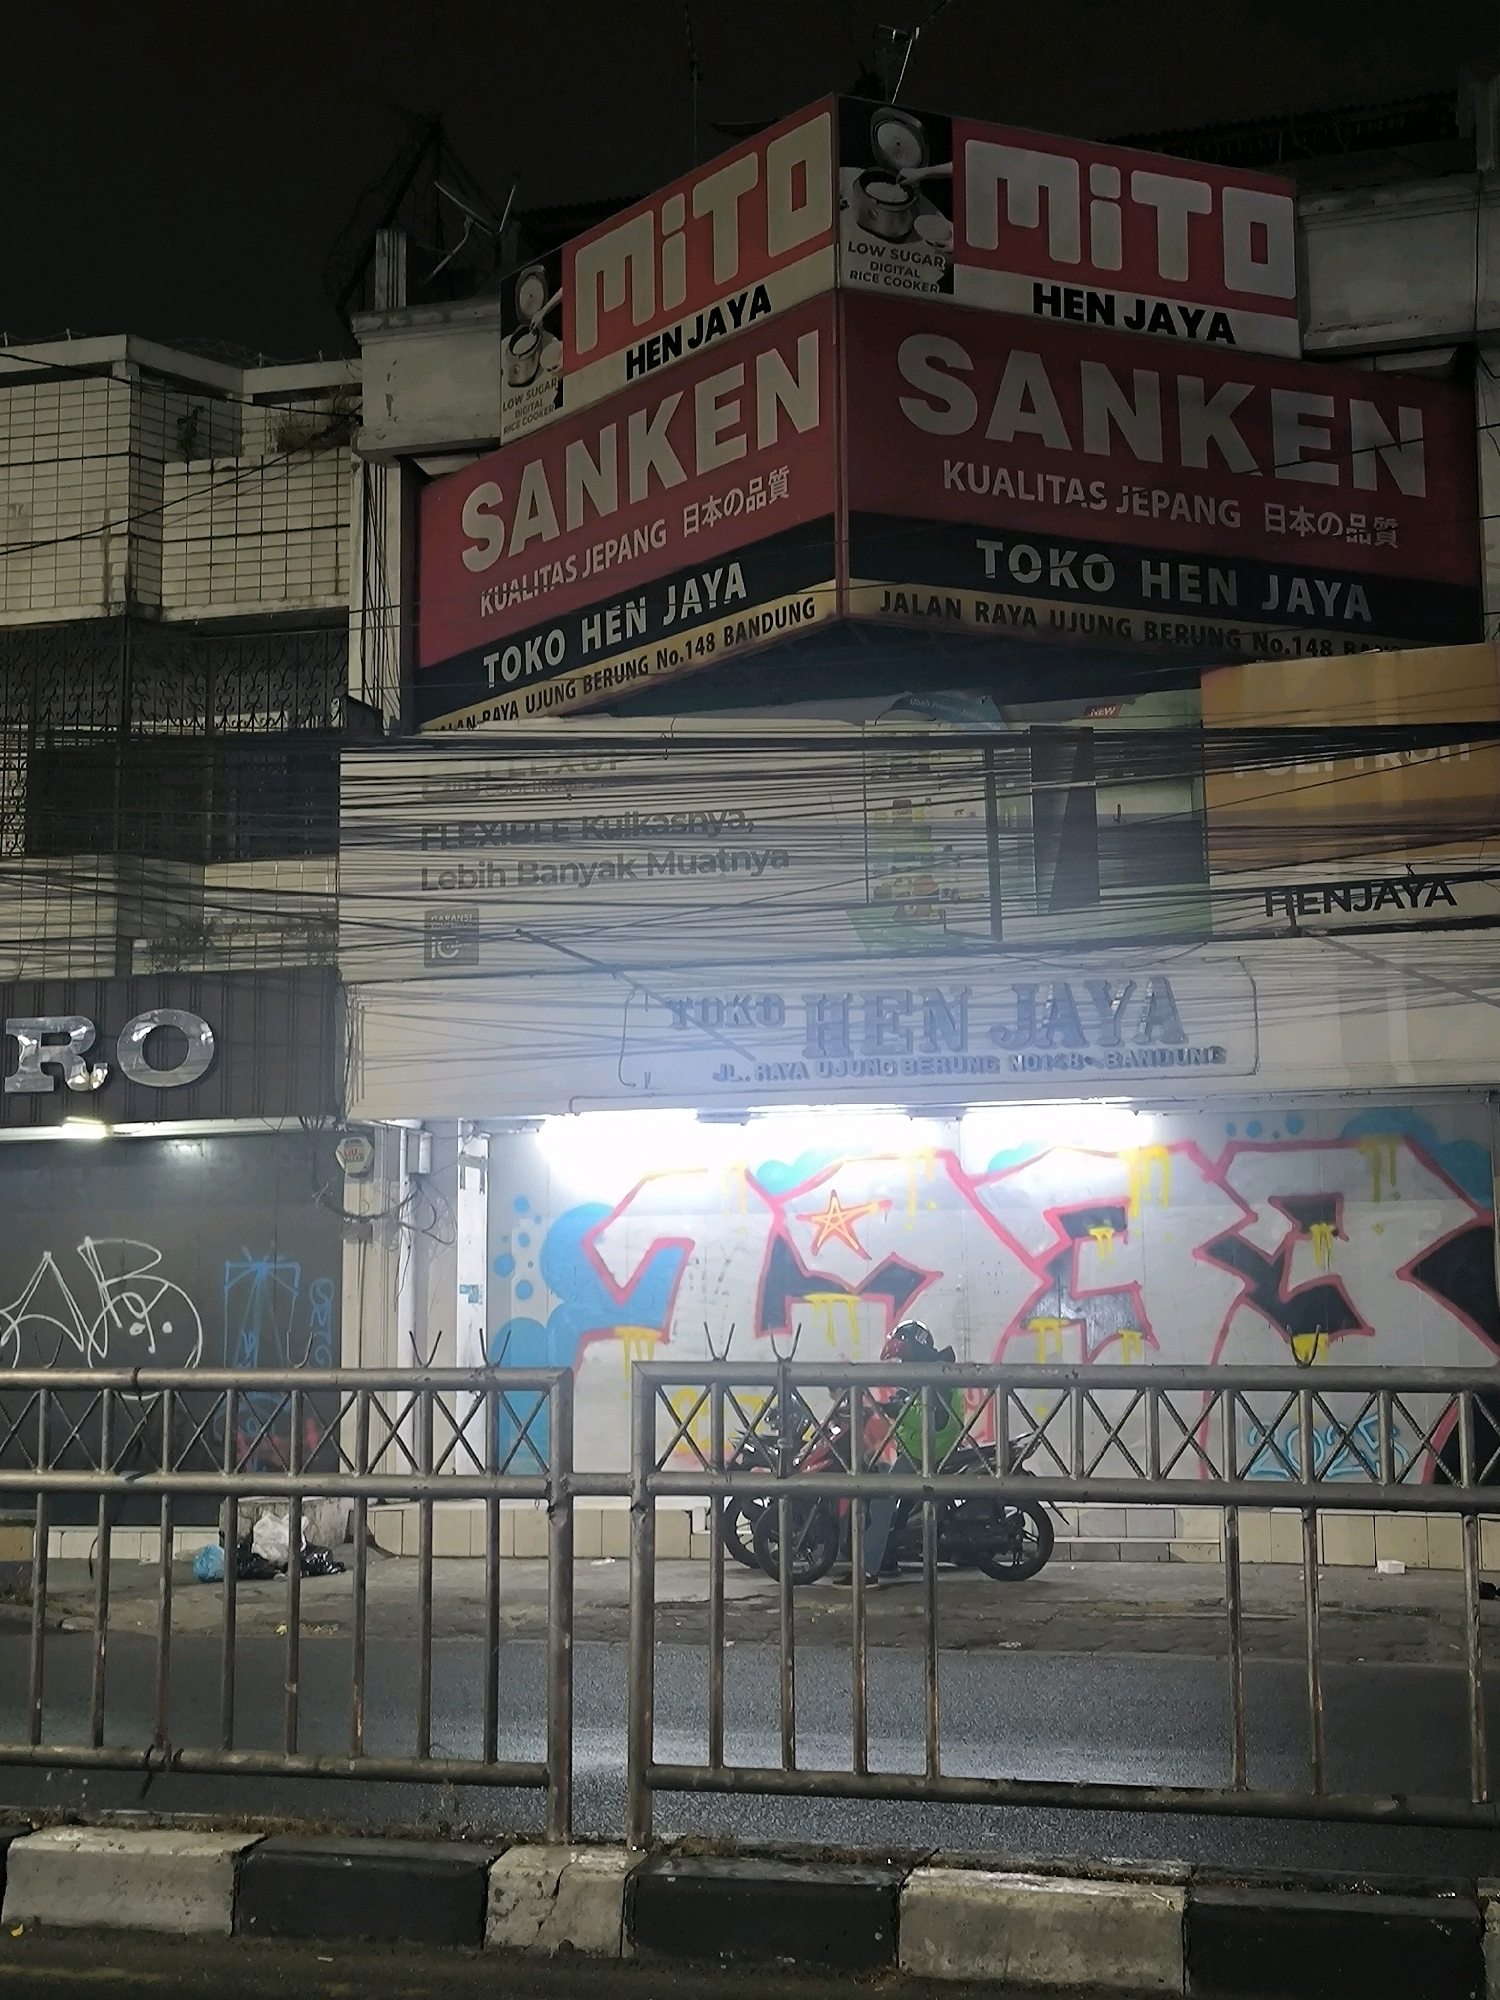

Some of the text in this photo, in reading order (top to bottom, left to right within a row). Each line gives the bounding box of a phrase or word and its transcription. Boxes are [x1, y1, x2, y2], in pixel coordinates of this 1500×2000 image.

[848, 240, 945, 269] LOW SUGAR
[849, 270, 940, 293] RICE COOKER
[870, 261, 920, 279] DIGITAL
[626, 284, 772, 381] HEN JAYA
[1032, 283, 1237, 345] HEN JAYA
[502, 378, 557, 412] LOW SUGAR
[503, 404, 554, 436] RICE COOKER
[515, 398, 543, 419] DIGITAL
[898, 333, 1427, 498] SANKEN
[461, 330, 820, 573] SANKEN
[943, 458, 1399, 549] KUALITAS JEPANG 日本の品質
[480, 464, 790, 618] KUALITAS JEPANG 日本の品質
[976, 538, 1372, 622] TOKO HEN JAYA
[483, 561, 747, 689] TOKO HEN JAYA
[880, 589, 962, 621] JALAN
[975, 600, 1038, 628] RAYA
[1049, 609, 1132, 640] UJUNG
[1144, 620, 1241, 652] BERUNG
[1253, 633, 1333, 658] No.148
[482, 700, 519, 722] RAYA
[525, 680, 577, 714] UJUNG
[583, 651, 649, 695] BERUNG
[656, 631, 716, 671] No.148
[724, 597, 816, 647] BANDUNG
[1090, 706, 1116, 717] NEW
[421, 848, 790, 891] Lebih Banyak Muatnya
[665, 976, 1190, 1060] TOKO HEN JAYA
[755, 1061, 810, 1082] RAYA
[815, 1058, 899, 1079] UJUNG
[901, 1055, 1000, 1077] BERUNG
[1104, 1045, 1228, 1069] BANDUNG
[1249, 1415, 1412, 1480] 2025
